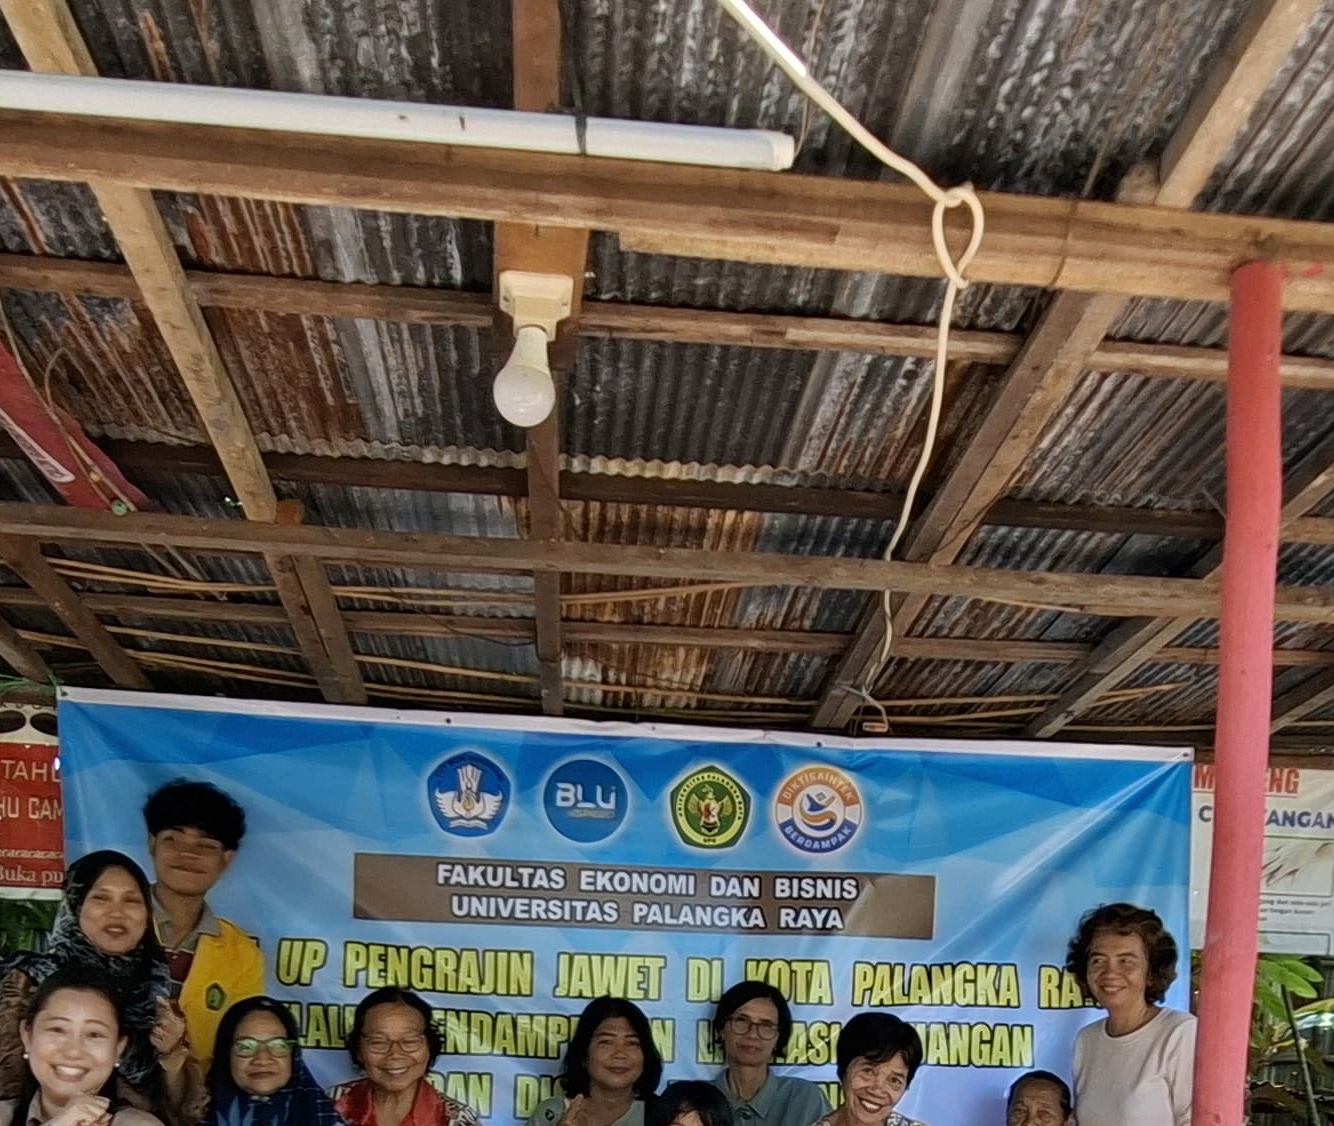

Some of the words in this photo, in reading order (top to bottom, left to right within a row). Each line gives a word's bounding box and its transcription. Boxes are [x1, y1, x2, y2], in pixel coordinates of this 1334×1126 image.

[555, 782, 616, 810] BLU
[784, 825, 852, 849] BERDAMPAK
[437, 863, 566, 889] FAKULTAS
[579, 869, 696, 896] EKONOMI
[709, 875, 760, 898] DAN
[774, 877, 858, 900] BISNIS
[451, 896, 619, 923] UNIVERSITAS
[632, 903, 766, 928] PALANGKA
[779, 908, 844, 930] RAYA
[276, 938, 328, 986] UP
[343, 941, 534, 997] PENGRAJIN
[554, 951, 667, 1001] JAWET
[687, 956, 723, 1003] DI
[745, 957, 834, 1006] KOTA
[852, 960, 1021, 1009] PALANGKA
[1037, 964, 1103, 1010] RA
